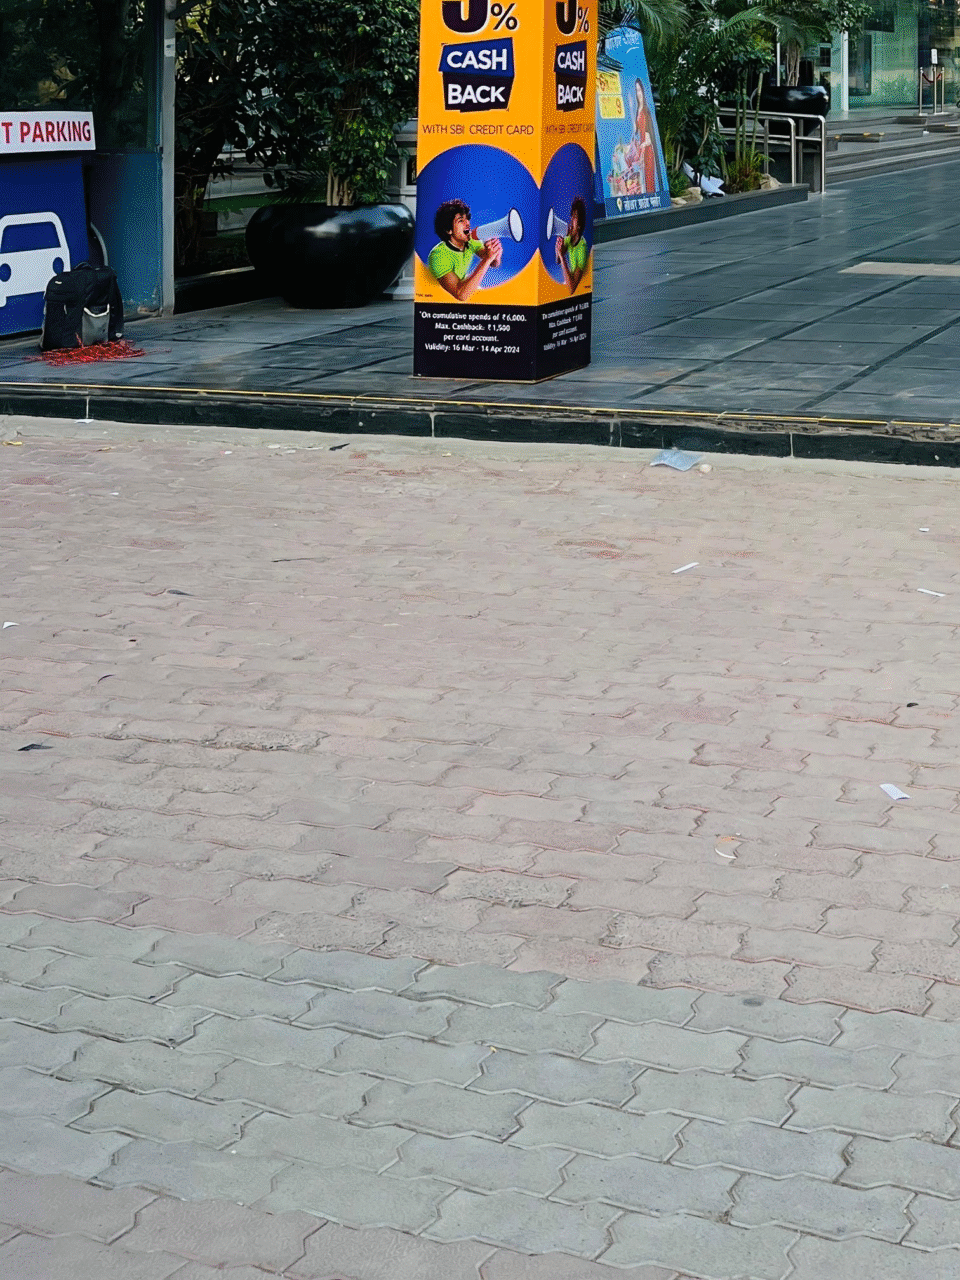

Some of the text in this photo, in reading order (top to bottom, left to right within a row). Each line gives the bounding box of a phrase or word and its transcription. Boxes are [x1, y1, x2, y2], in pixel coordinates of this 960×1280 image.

[446, 49, 507, 70] CASH
[557, 51, 585, 72] CASH
[447, 84, 506, 104] BACK
[557, 84, 584, 104] BACK
[20, 121, 92, 143] PARKING
[423, 124, 534, 136] WITH SBI CREDIT CARD
[443, 334, 455, 342] per
